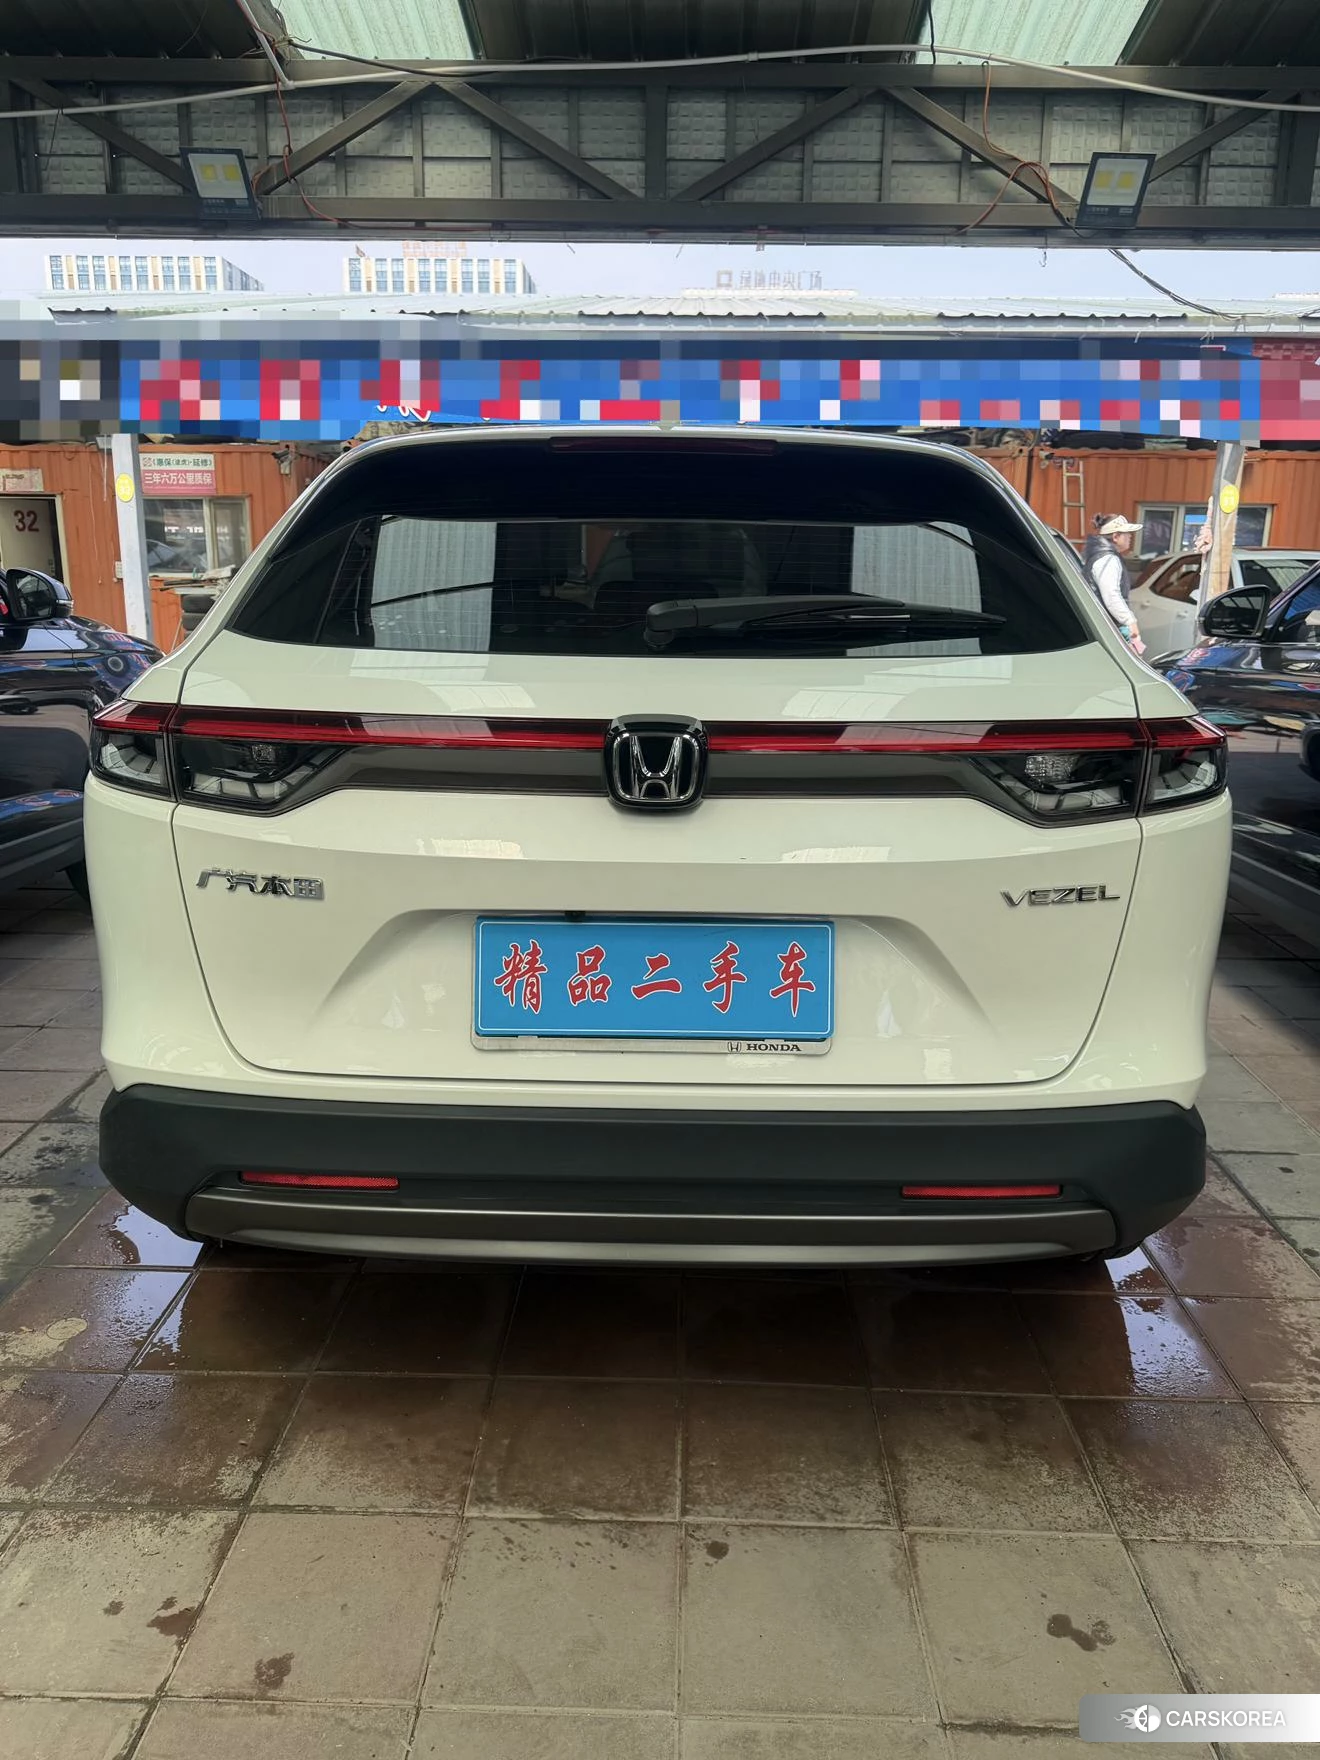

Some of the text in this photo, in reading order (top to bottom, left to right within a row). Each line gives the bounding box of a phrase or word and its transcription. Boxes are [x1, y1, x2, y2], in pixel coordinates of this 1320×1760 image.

[144, 472, 212, 485] 三年六万公里质保
[13, 509, 40, 532] 32
[196, 867, 325, 901] 广汽本田
[1000, 885, 1120, 907] VEZEL
[494, 939, 816, 1018] 精品二手车
[746, 1043, 802, 1052] HONDA
